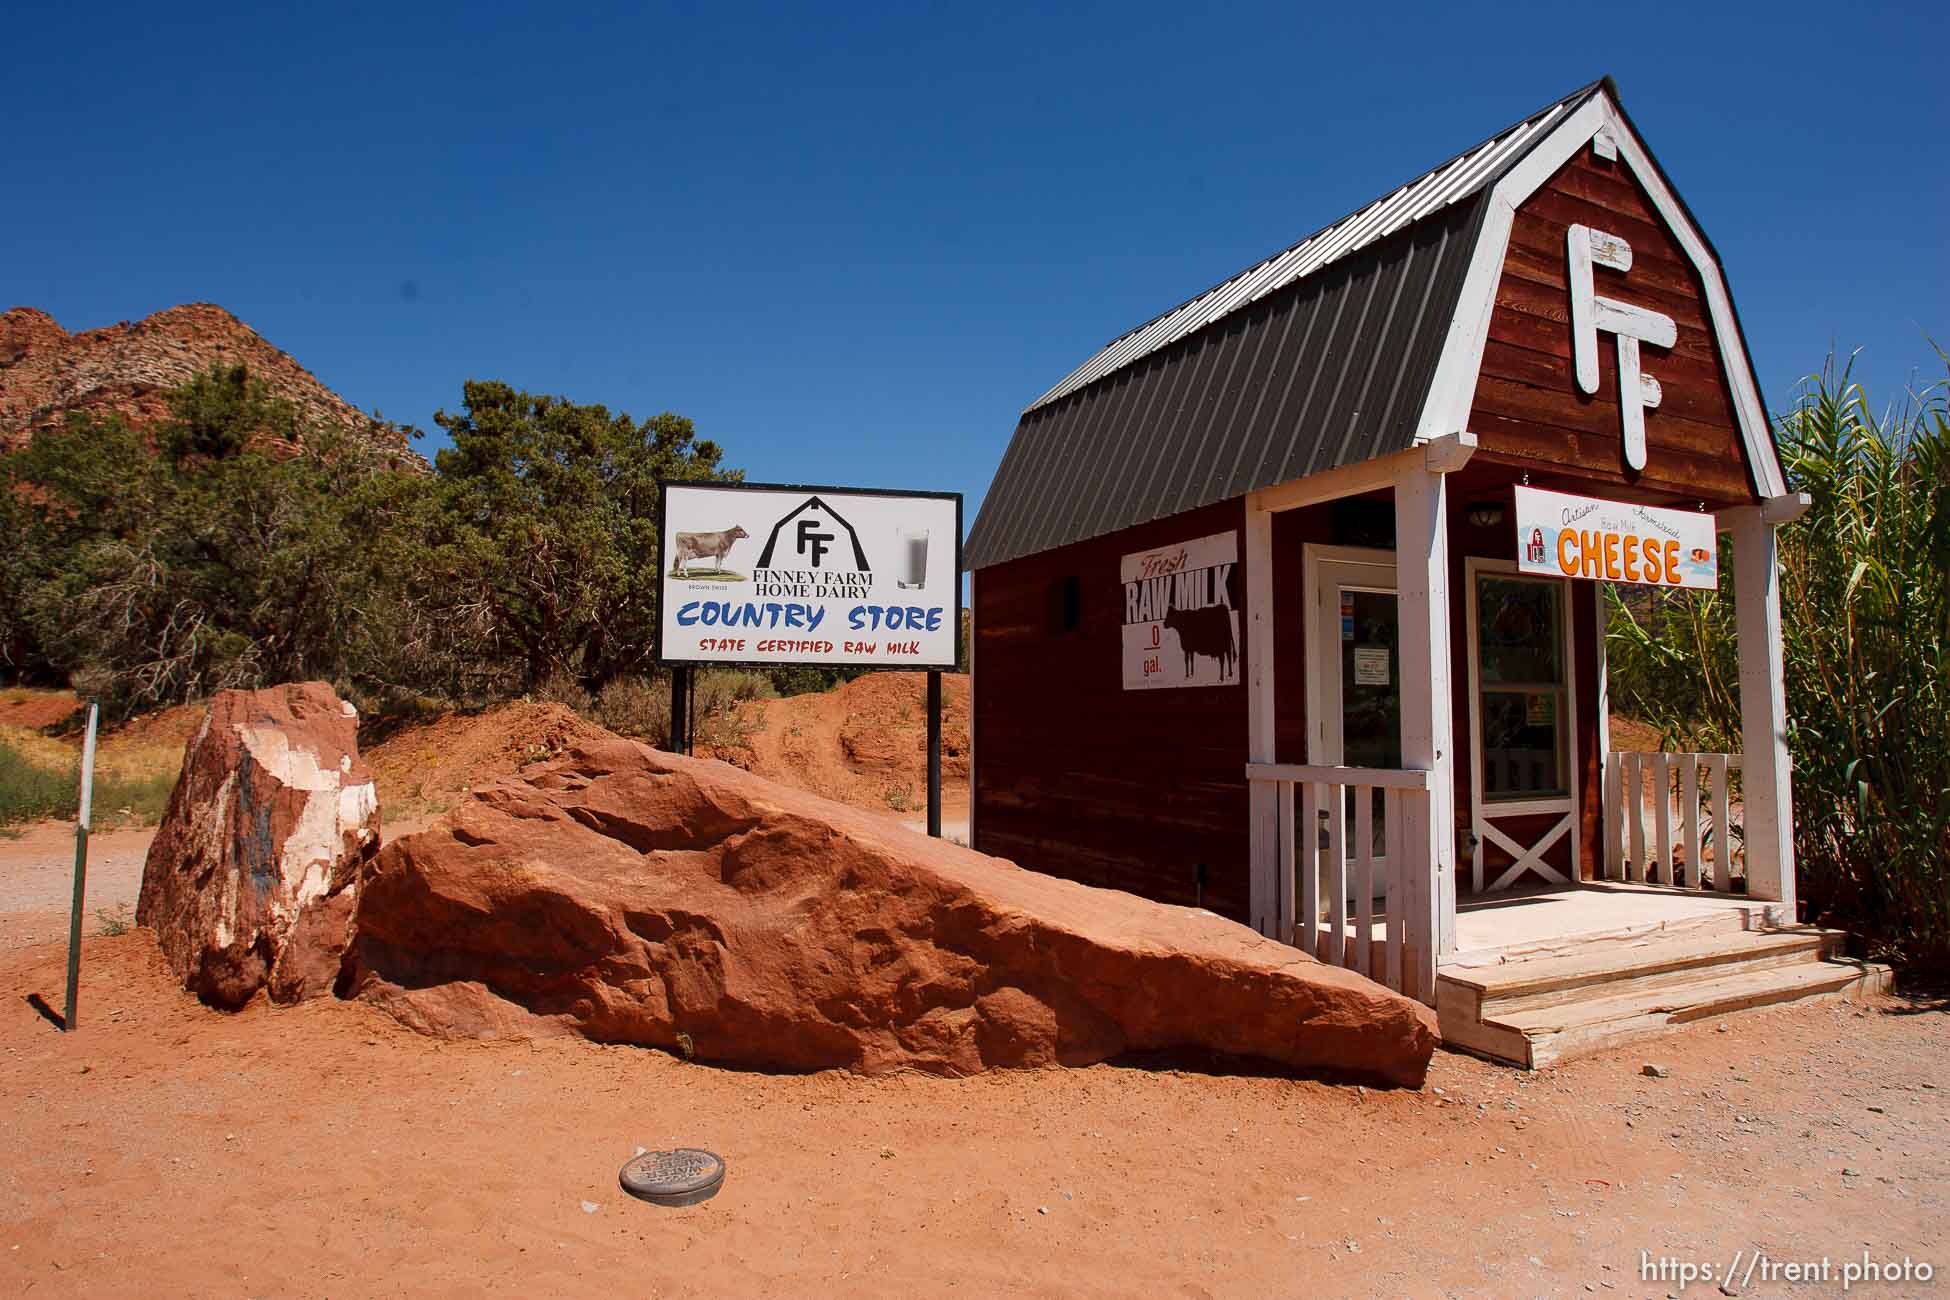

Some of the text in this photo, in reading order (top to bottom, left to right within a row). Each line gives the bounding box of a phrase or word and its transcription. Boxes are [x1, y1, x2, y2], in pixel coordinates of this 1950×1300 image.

[1141, 549, 1188, 577] Fresh
[1557, 527, 1682, 585] CHEESE
[752, 569, 873, 586] FINNEY FARM
[755, 583, 871, 599] HOME DAIRY
[1126, 564, 1232, 625] RAW MILK
[676, 601, 944, 632] COUNTRY STORE
[699, 638, 920, 655] STATE CERTIFIED RAW MILK
[1143, 656, 1162, 677] gal.
